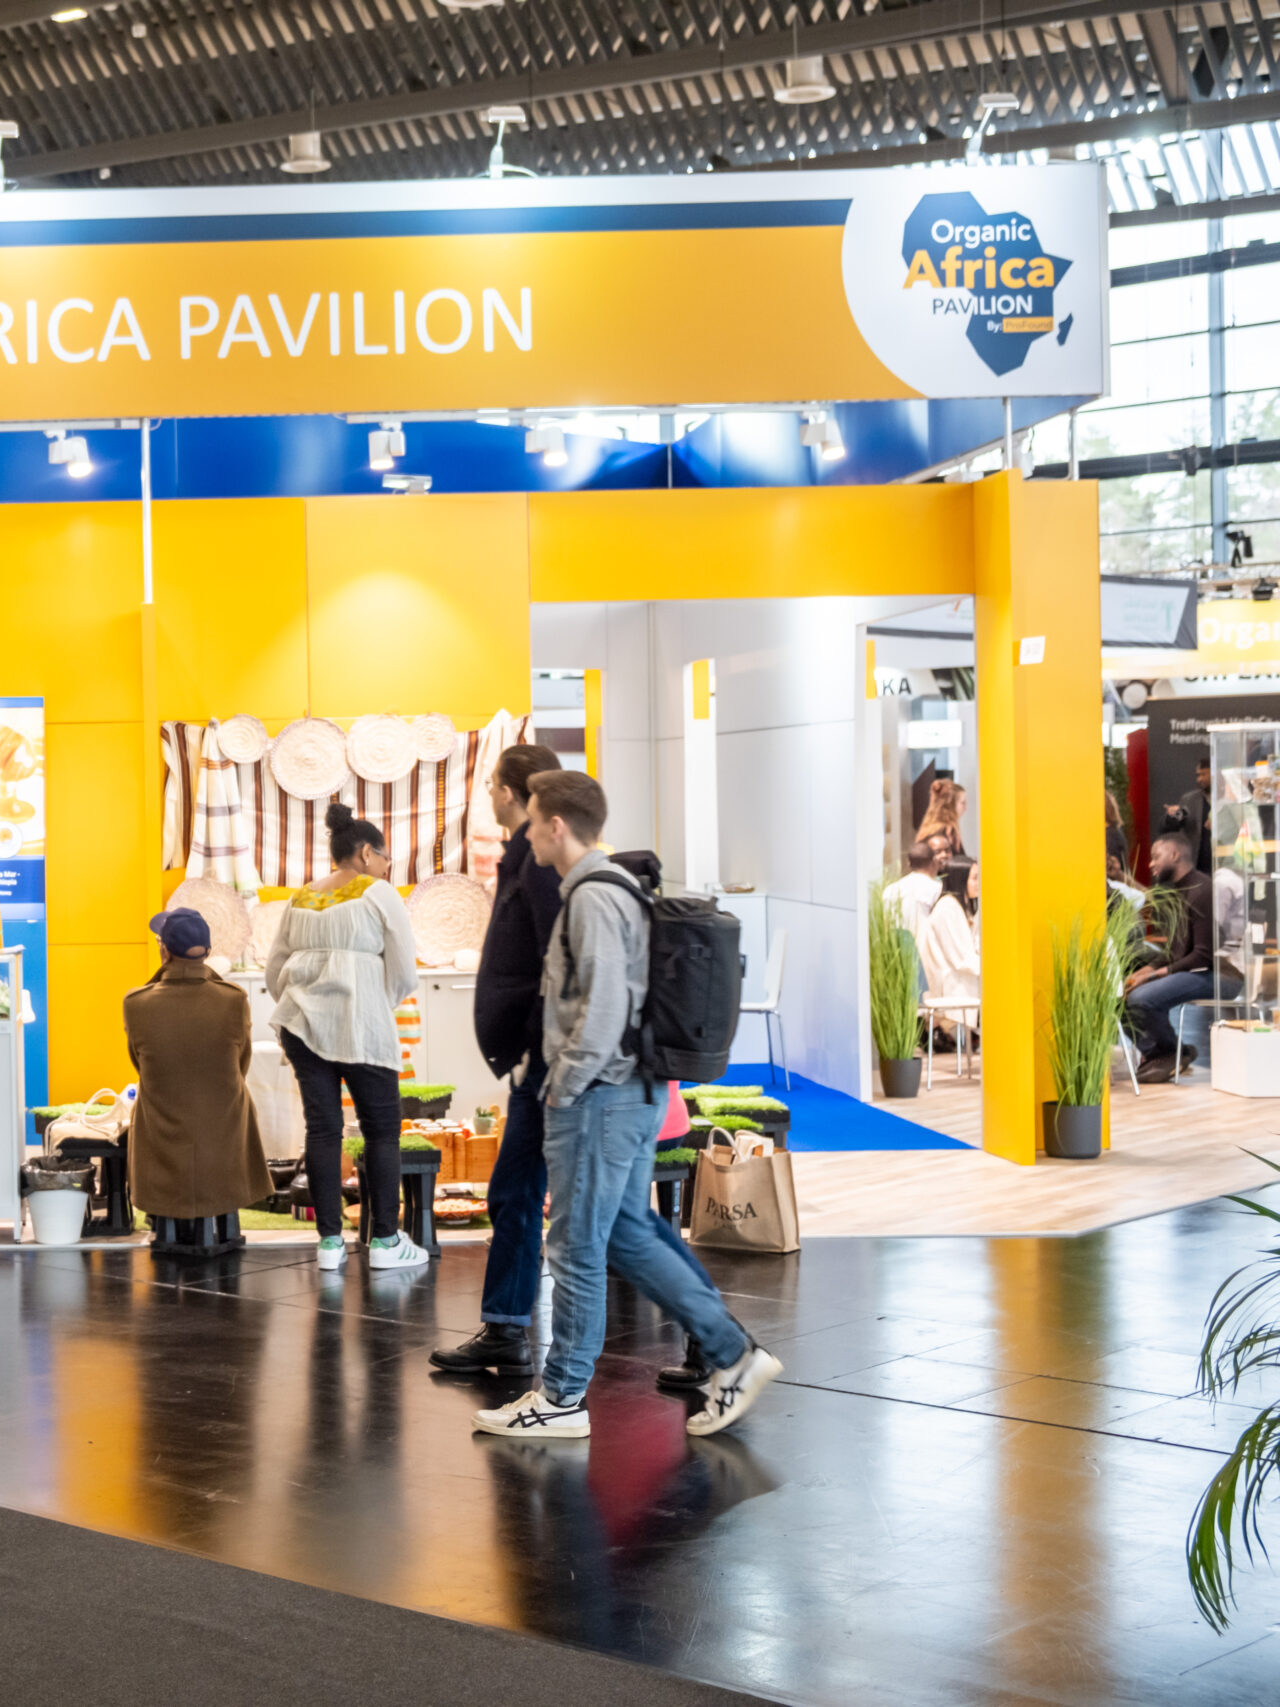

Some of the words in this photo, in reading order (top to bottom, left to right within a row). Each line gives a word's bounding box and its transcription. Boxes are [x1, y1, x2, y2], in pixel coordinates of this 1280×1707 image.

[931, 218, 1031, 249] Organic
[902, 245, 1054, 289] Africa
[932, 294, 1033, 315] PAVILION
[179, 286, 533, 360] PAVILION
[1199, 617, 1280, 650] Orga
